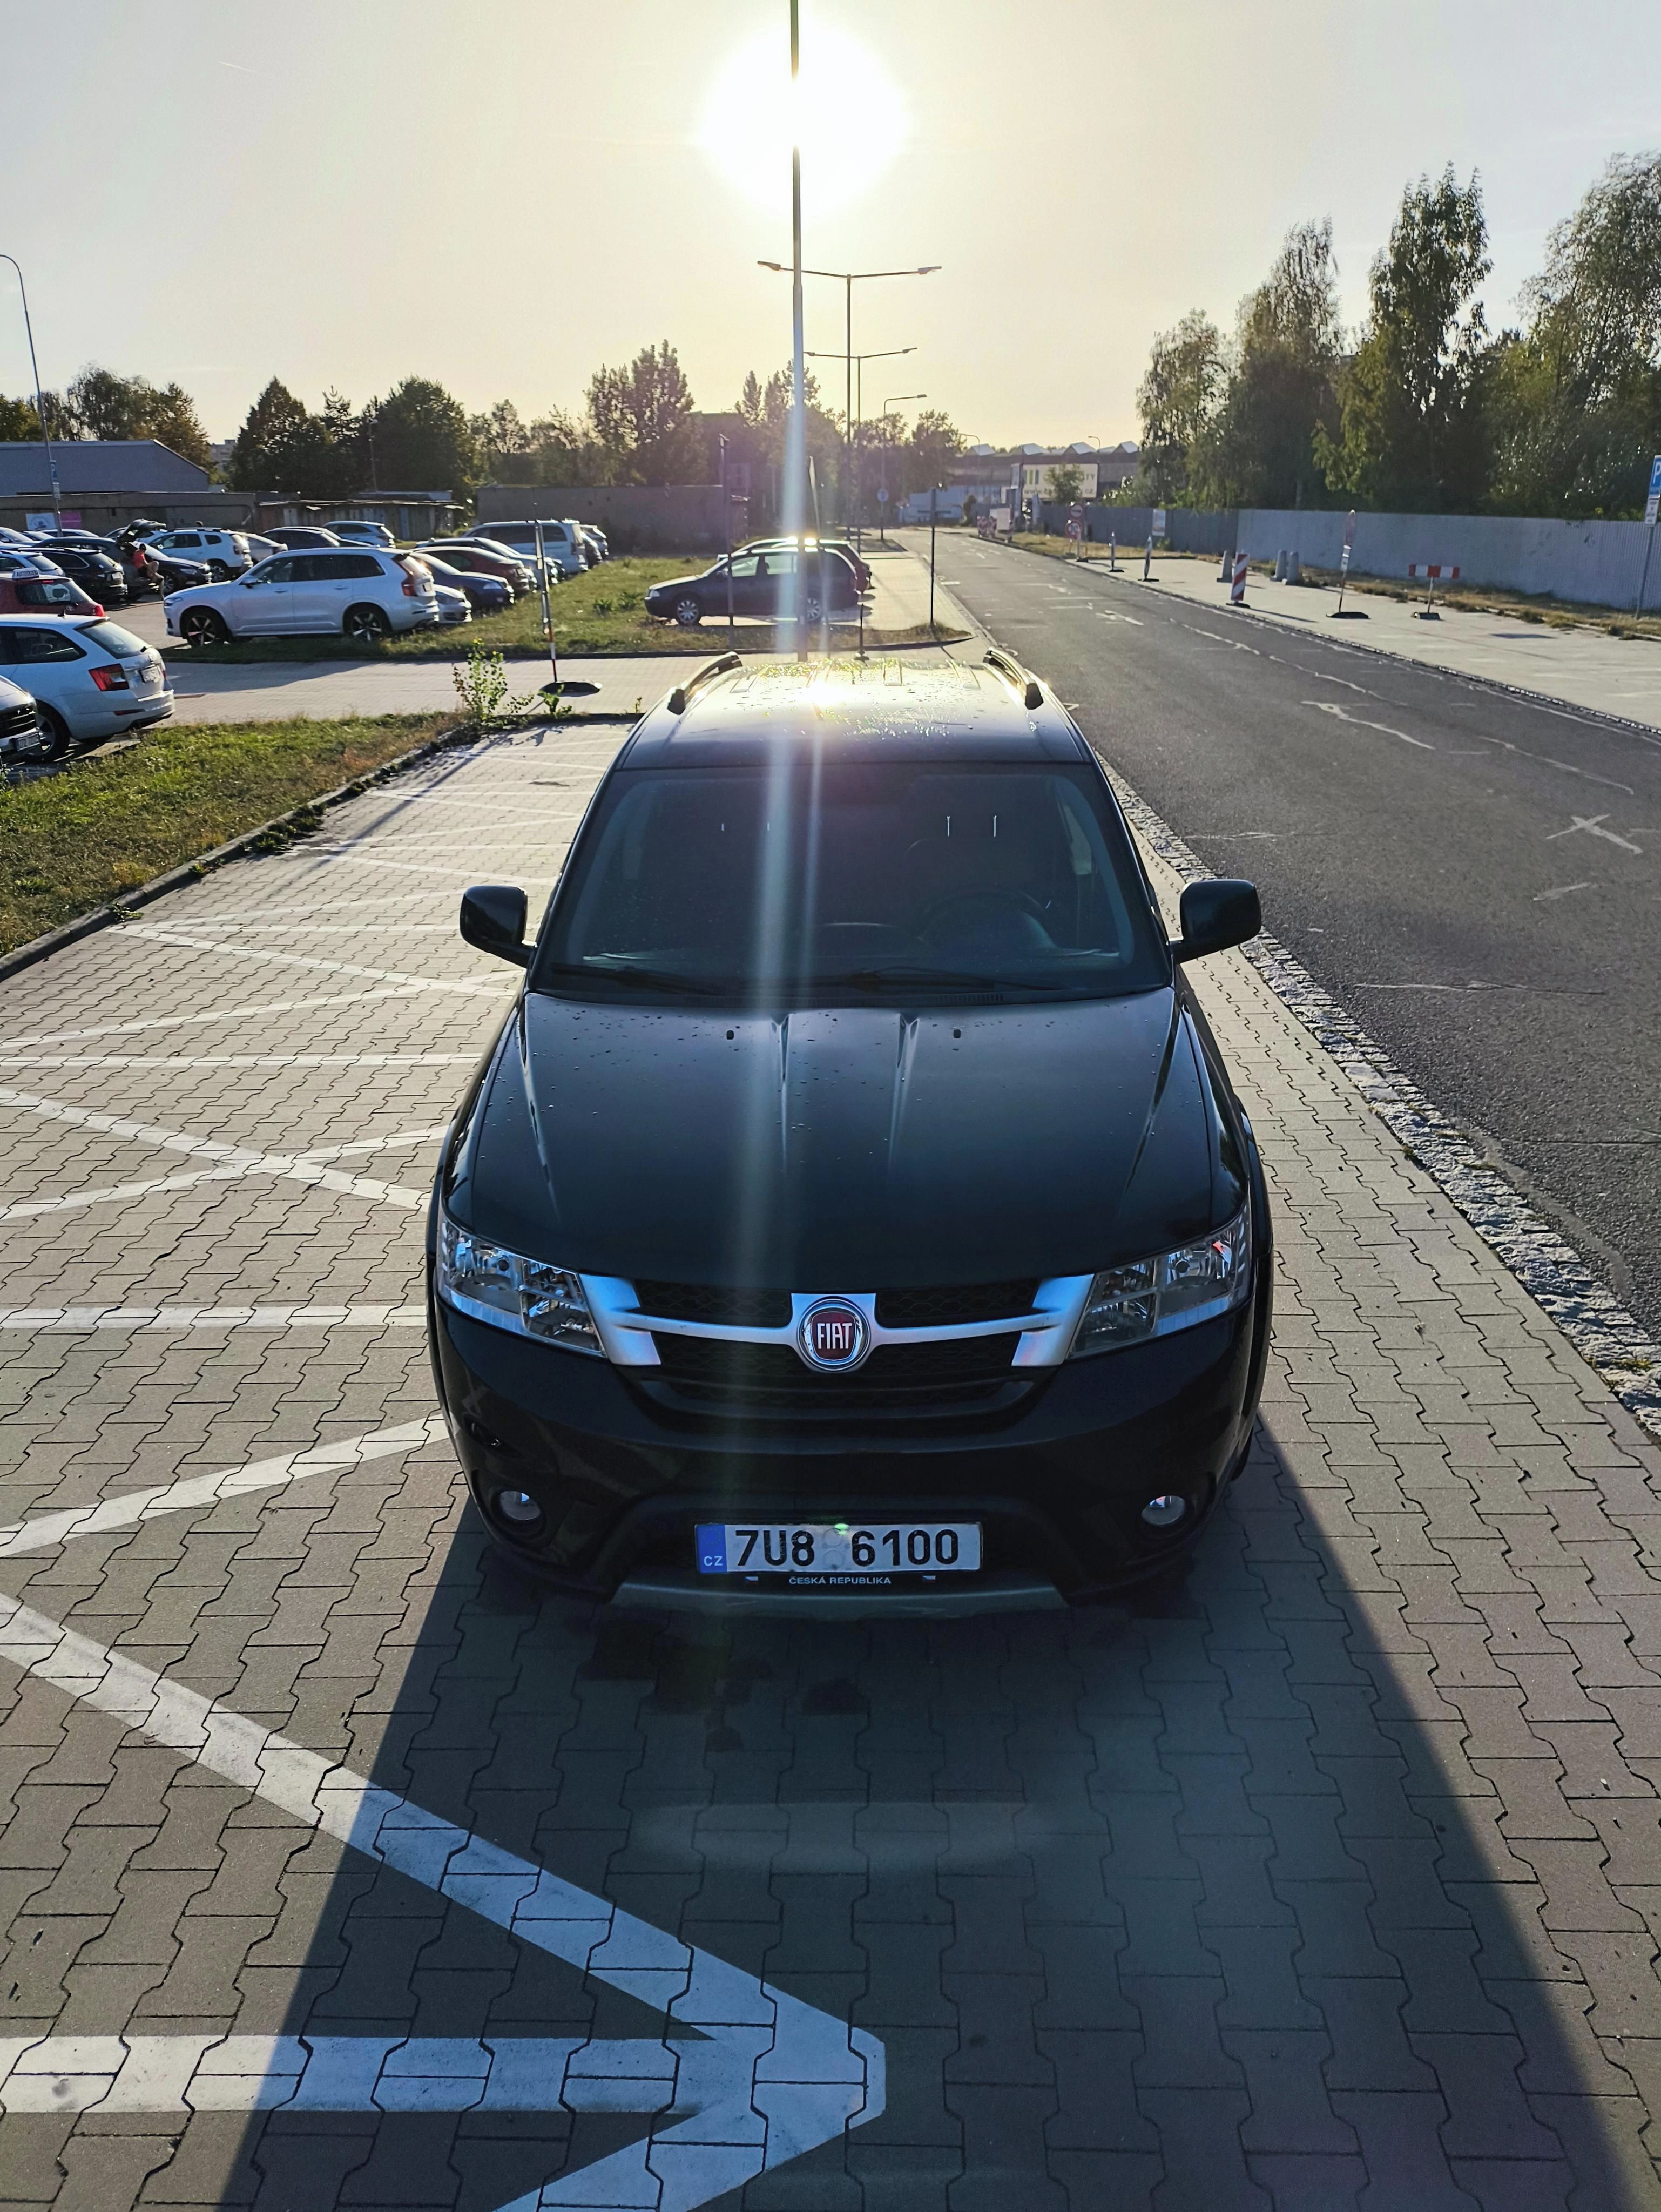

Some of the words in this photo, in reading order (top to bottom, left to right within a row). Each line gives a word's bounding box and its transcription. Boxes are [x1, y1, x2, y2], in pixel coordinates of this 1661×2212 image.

[817, 1323, 852, 1349] FIAT
[735, 1530, 814, 1566] 7U8
[852, 1529, 958, 1566] 6100
[704, 1555, 723, 1566] CZ
[789, 1576, 826, 1584] ČESKÁ
[829, 1576, 891, 1584] REPUBLIKA
